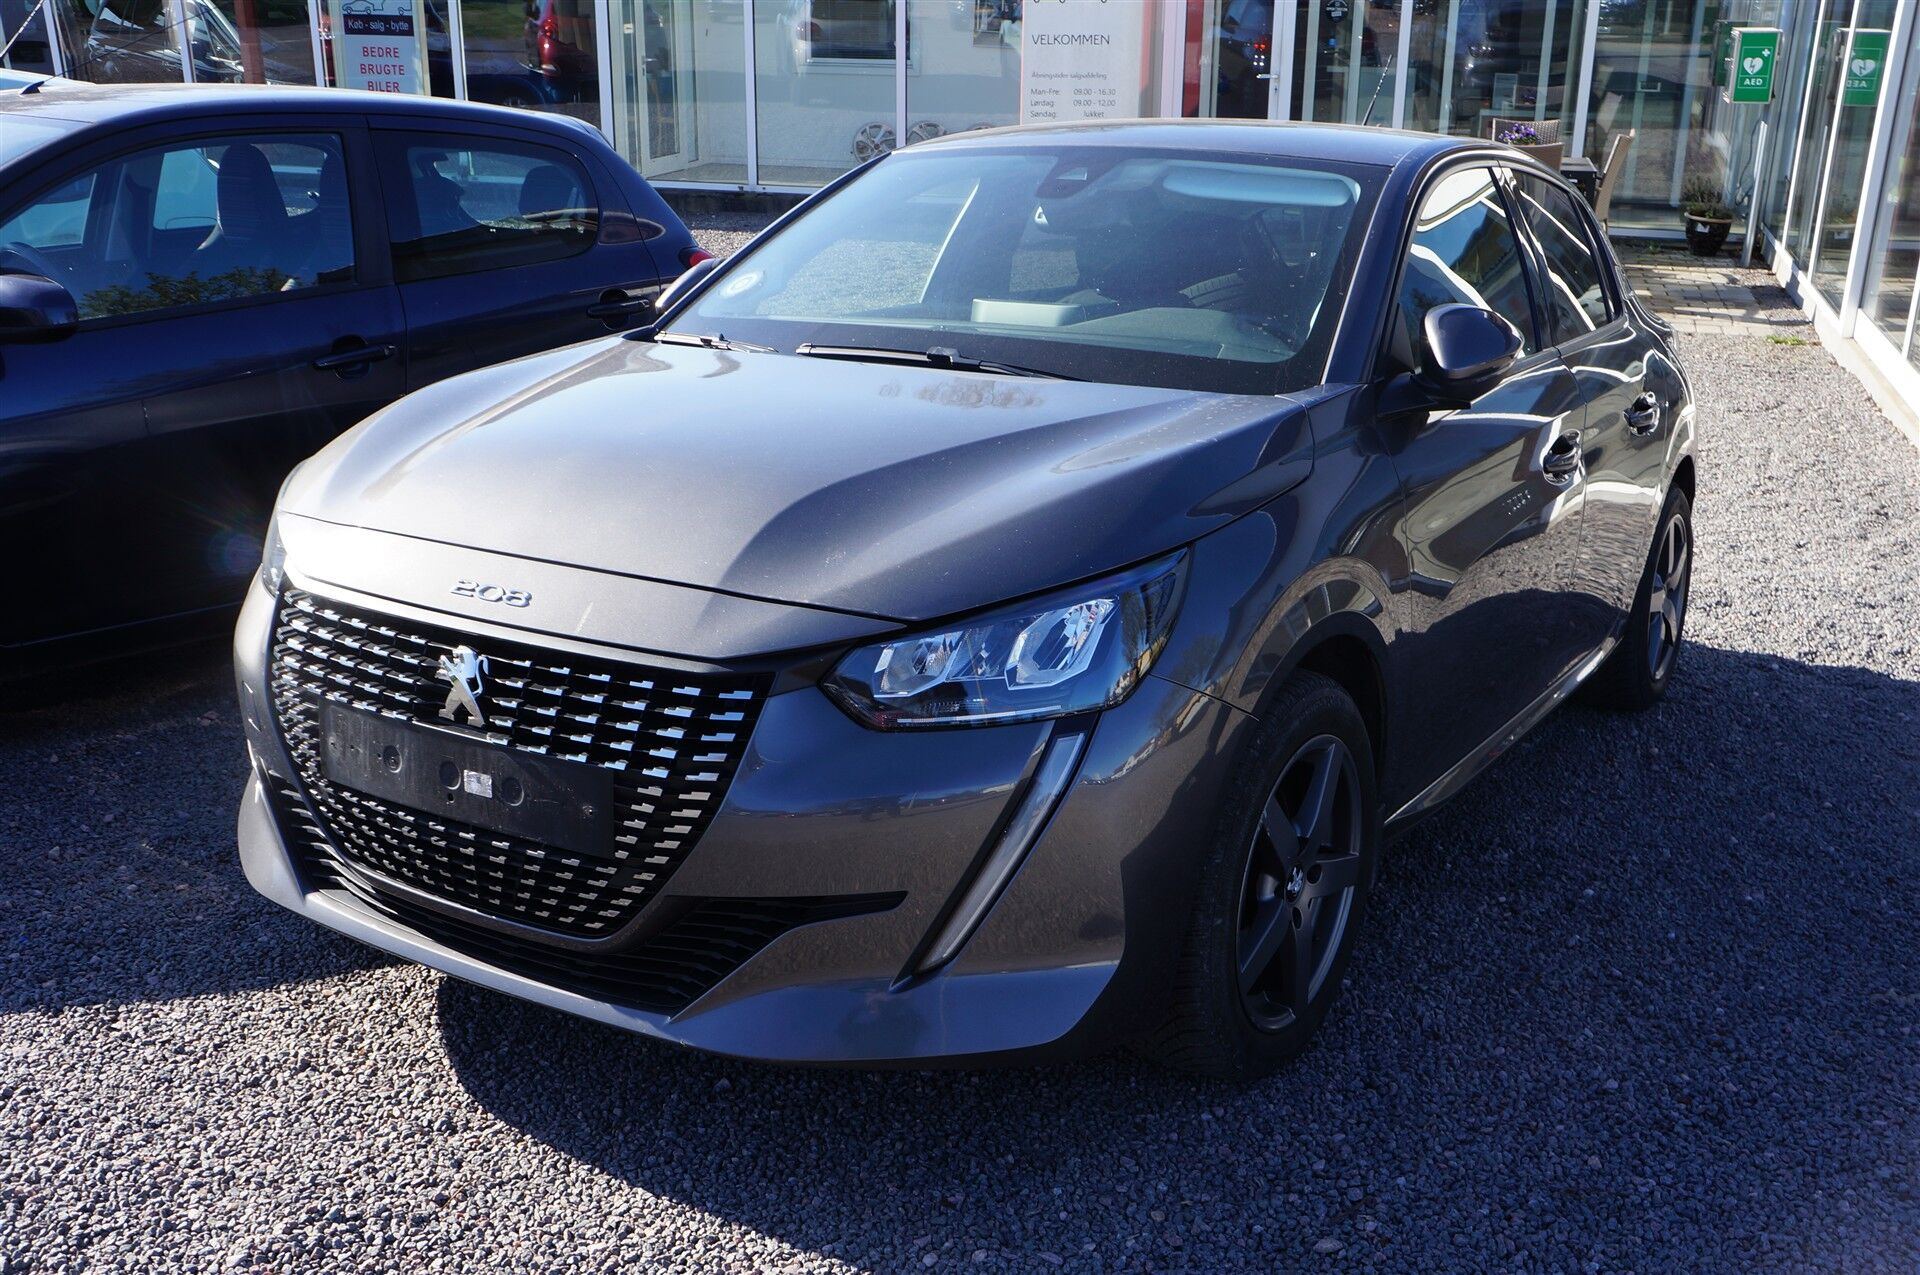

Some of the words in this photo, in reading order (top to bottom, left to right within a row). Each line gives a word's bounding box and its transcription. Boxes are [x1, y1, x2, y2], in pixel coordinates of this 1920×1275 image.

[348, 19, 364, 29] Køb
[369, 20, 385, 32] salg
[391, 20, 409, 32] bytte
[1031, 34, 1110, 46] VELKOMMEN
[362, 46, 400, 58] BEDRE
[359, 63, 405, 75] BRUGTE
[367, 81, 401, 93] BILER
[1743, 78, 1763, 86] AED
[450, 579, 533, 608] 208
